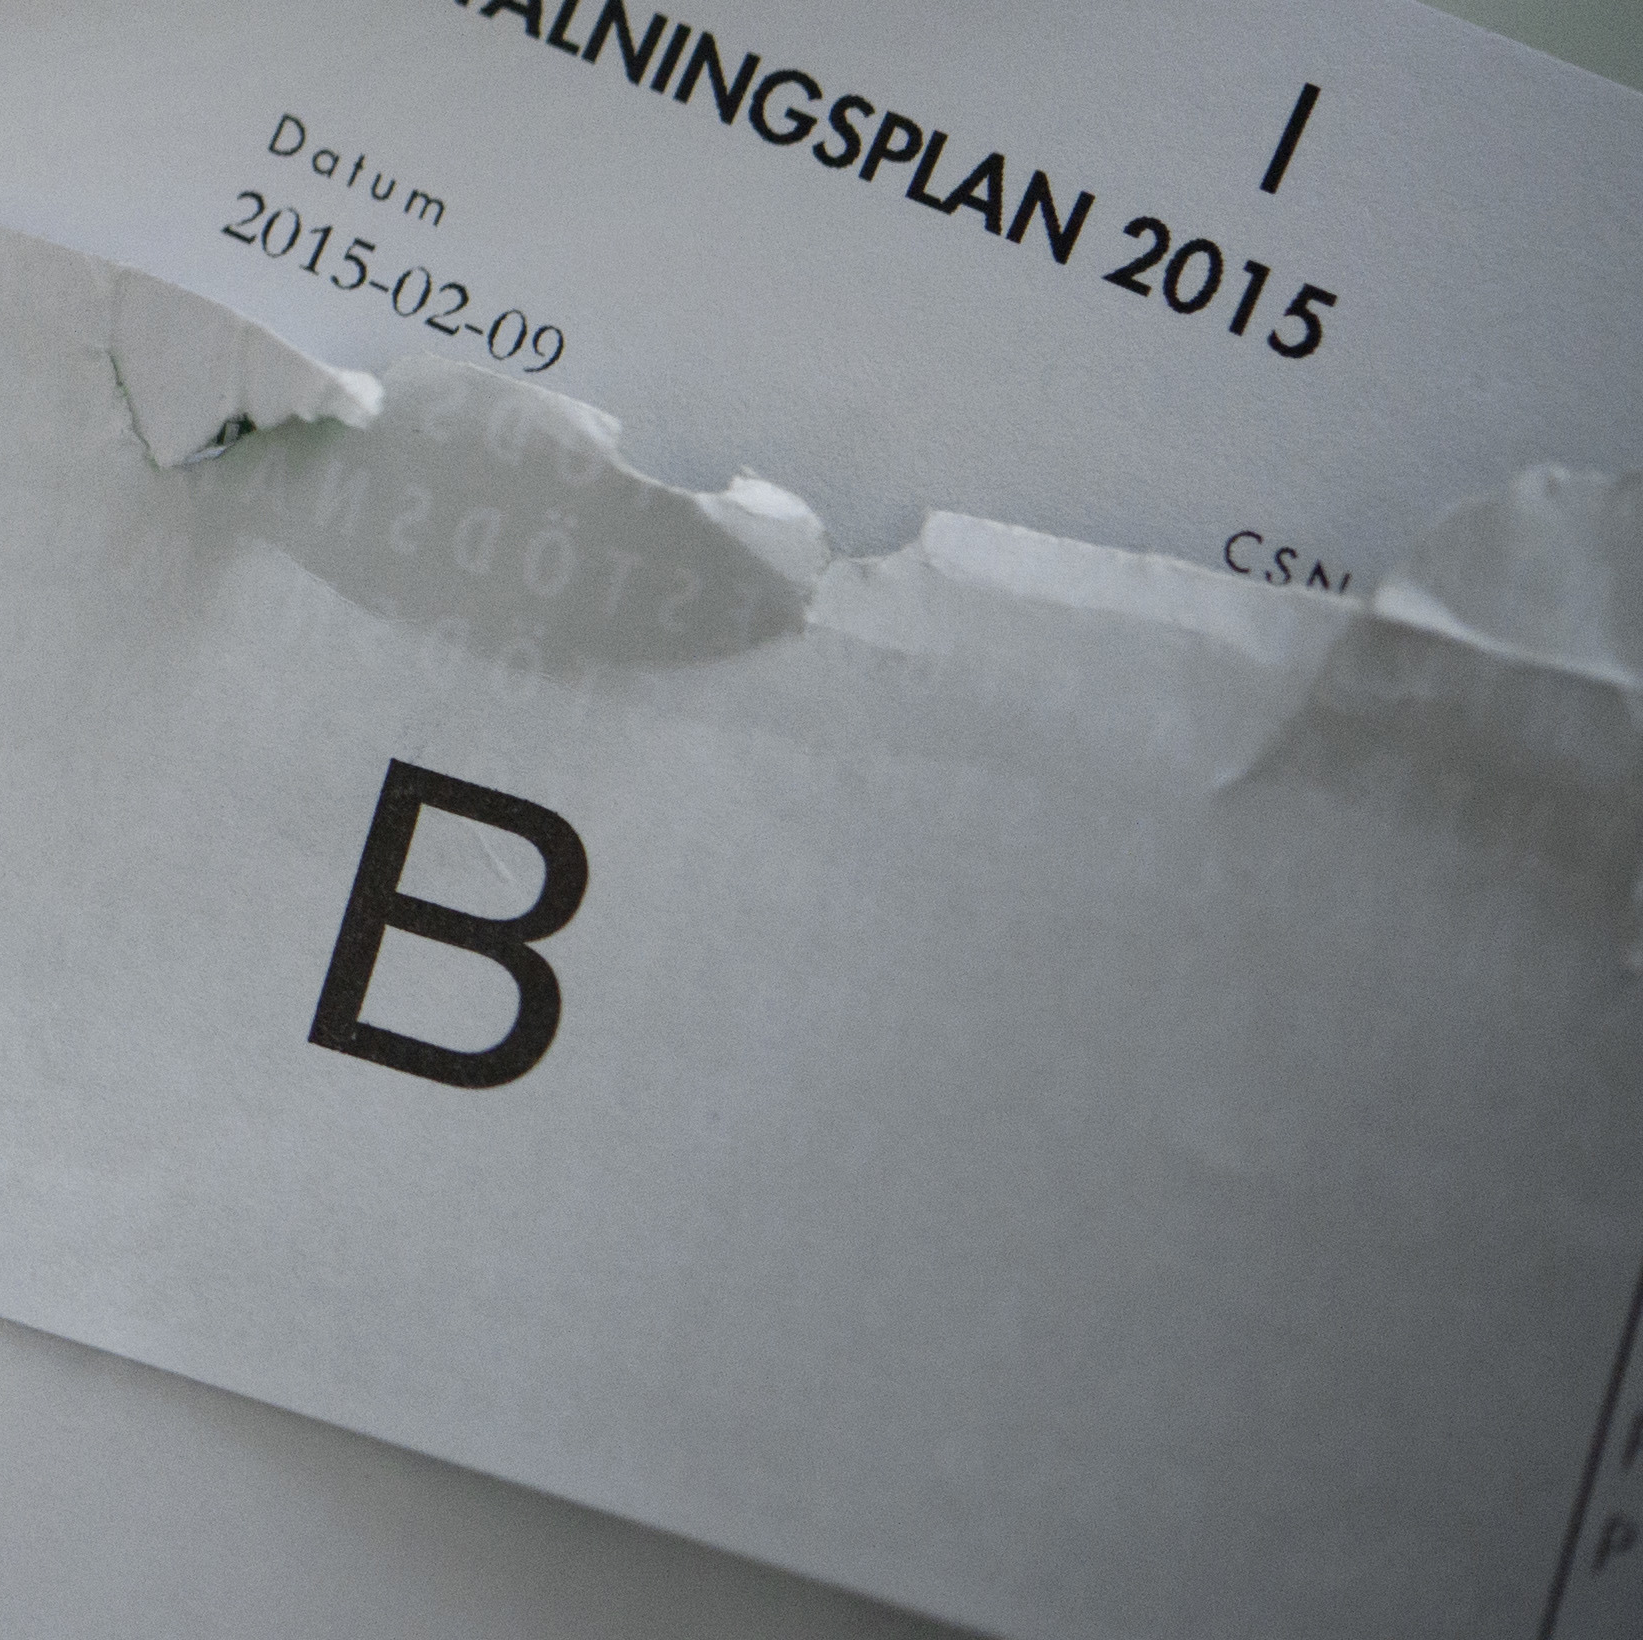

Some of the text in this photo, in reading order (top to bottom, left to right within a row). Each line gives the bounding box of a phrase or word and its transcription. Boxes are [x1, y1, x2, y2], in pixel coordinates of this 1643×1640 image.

[267, 113, 447, 227] Datum
[221, 188, 566, 374] 2015-02-09
[1103, 216, 1338, 361] 2015
[307, 758, 590, 1090] B
